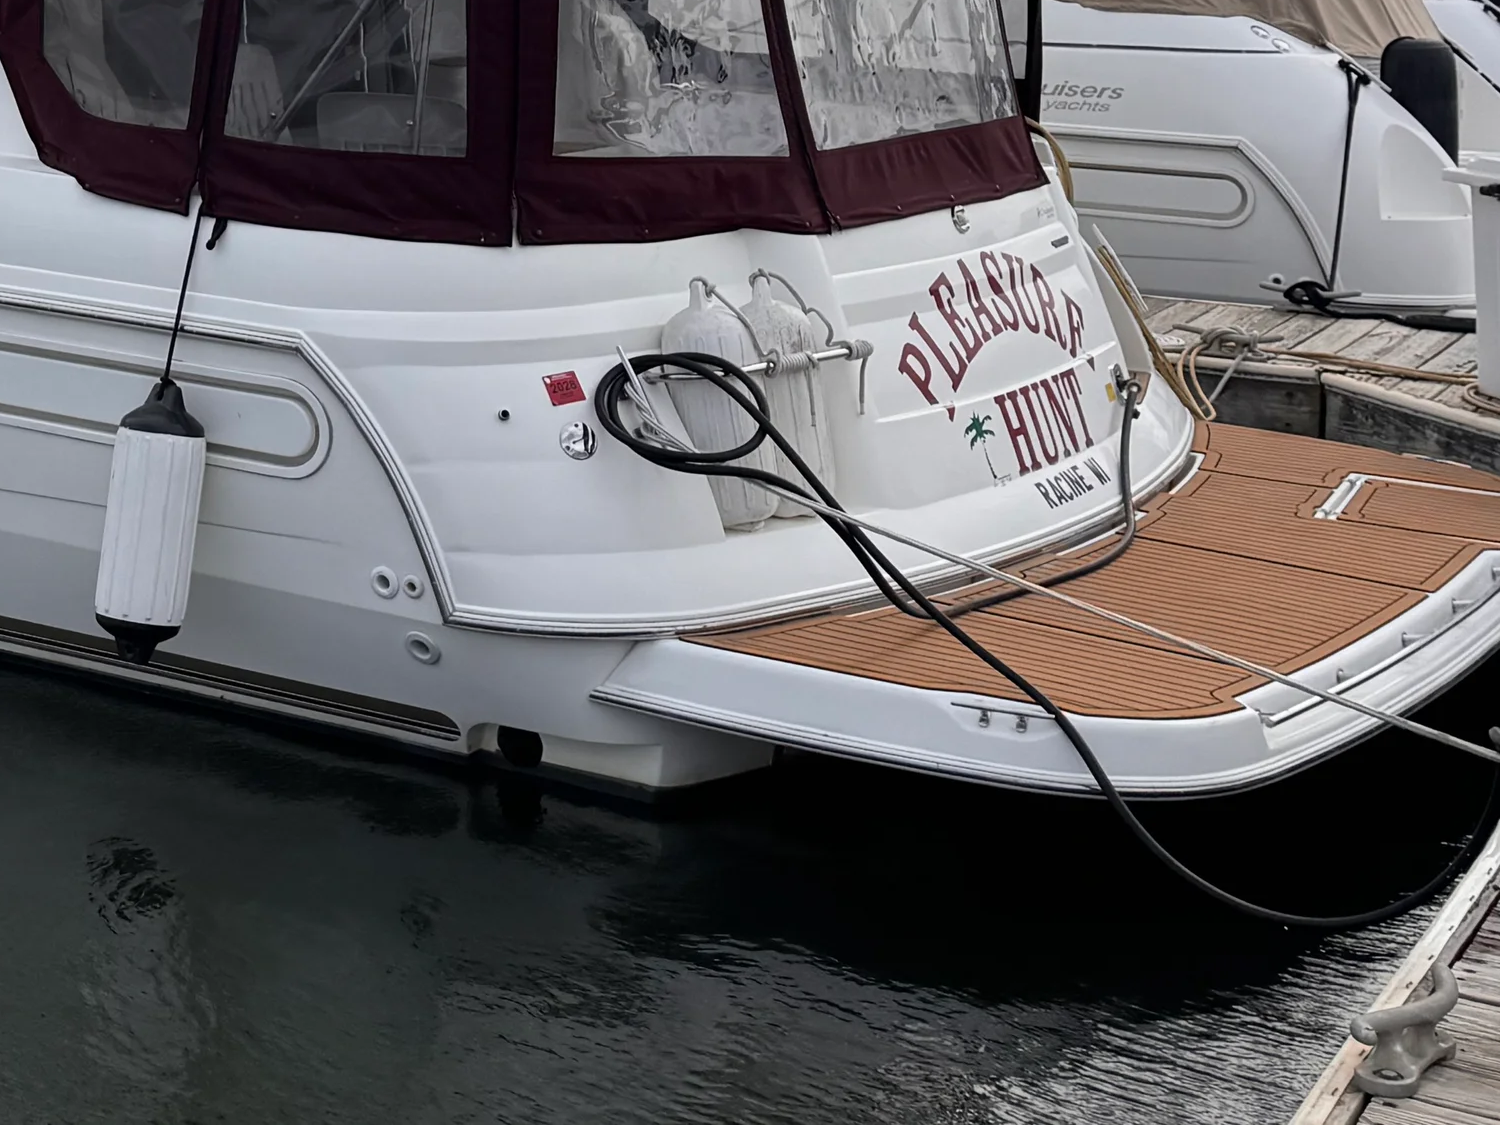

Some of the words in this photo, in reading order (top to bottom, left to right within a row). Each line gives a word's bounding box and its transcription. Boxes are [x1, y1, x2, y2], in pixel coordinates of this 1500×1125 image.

[1041, 81, 1125, 100] uisers
[1043, 99, 1111, 113] yachts
[897, 250, 1096, 422] PLEASURE
[994, 368, 1095, 477] HUNT
[1034, 465, 1095, 509] RACINE
[1083, 457, 1112, 485] WI
